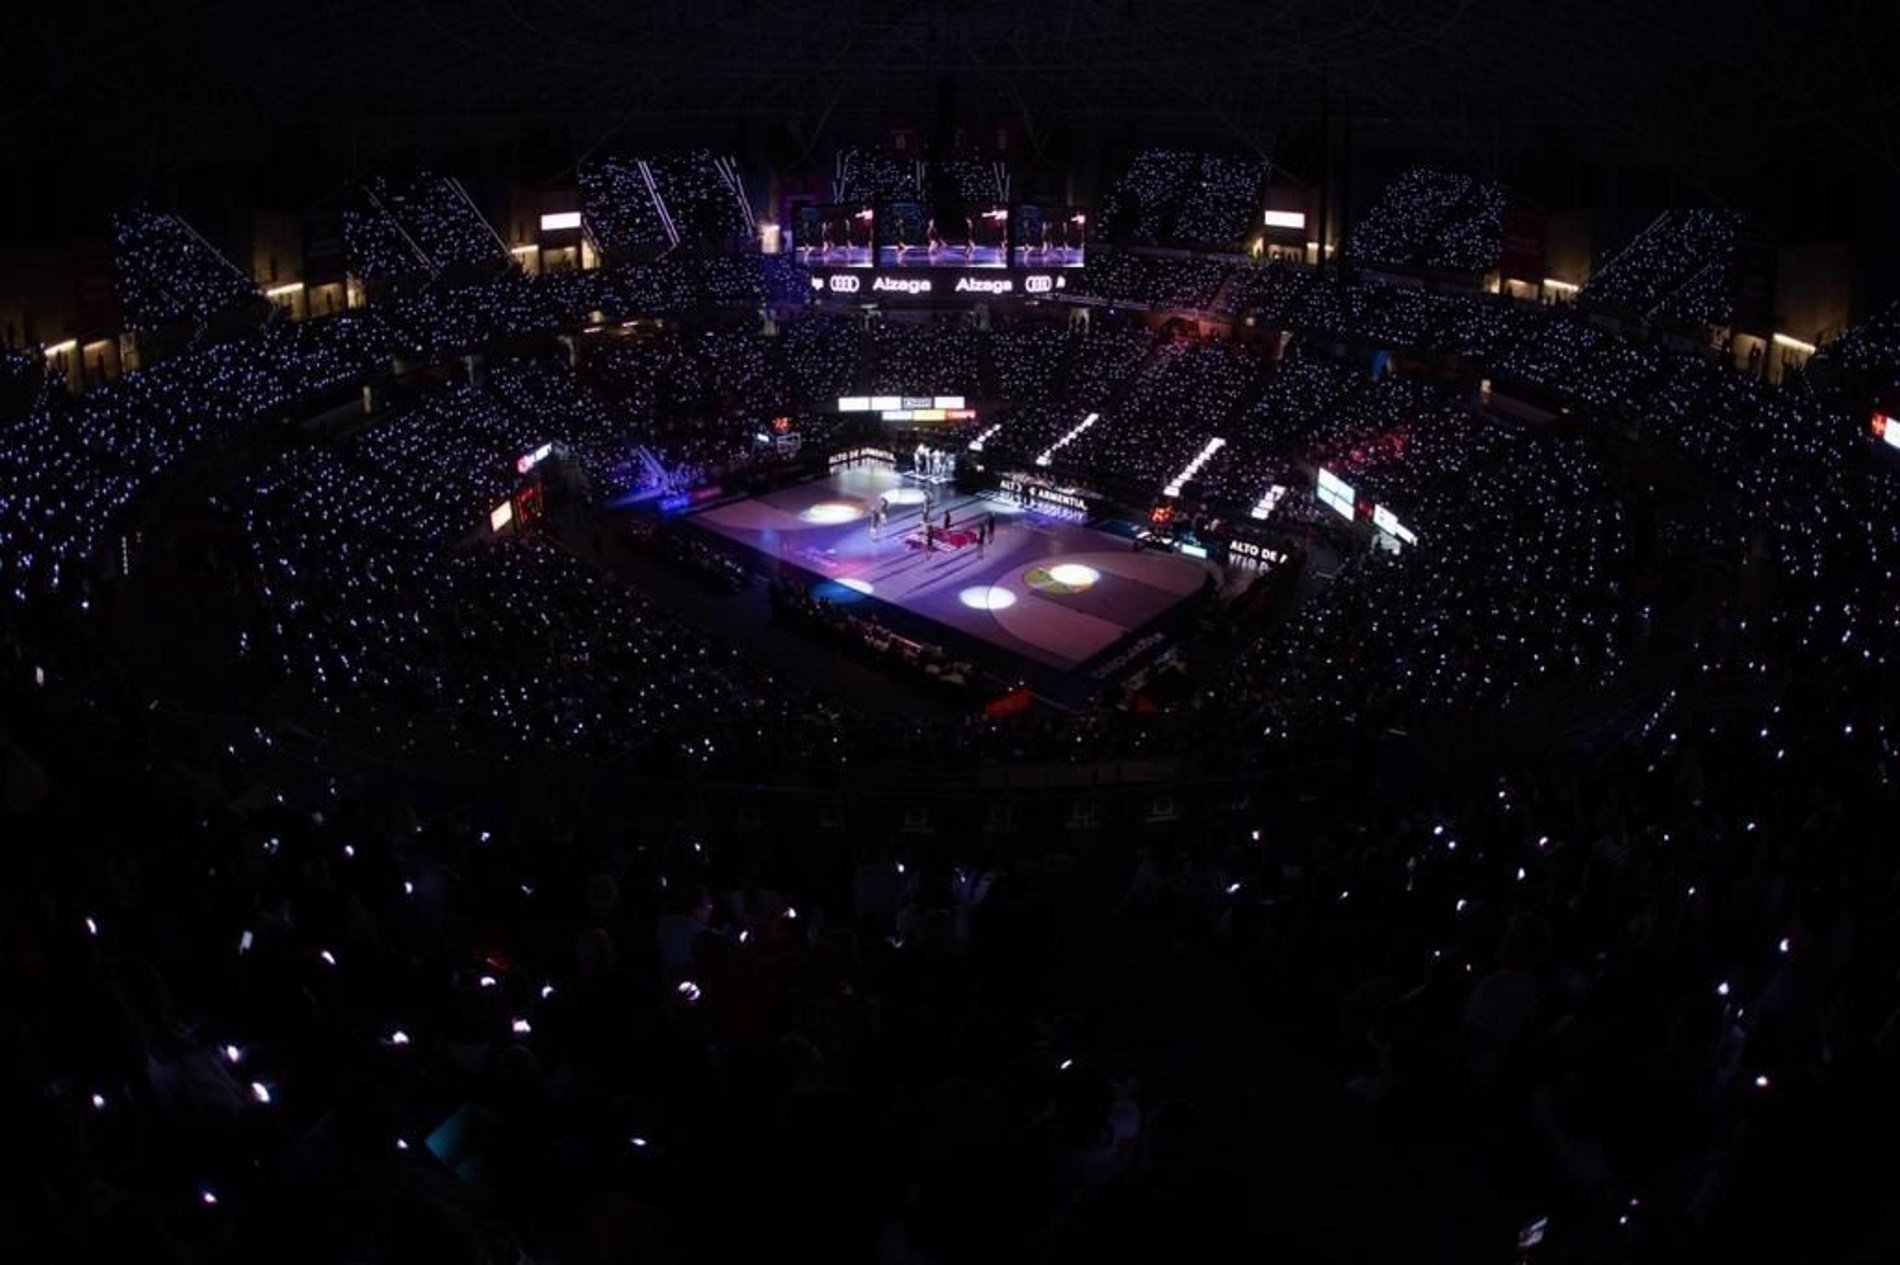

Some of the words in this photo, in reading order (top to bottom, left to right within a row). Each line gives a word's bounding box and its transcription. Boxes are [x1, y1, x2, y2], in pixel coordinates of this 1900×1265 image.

[873, 277, 931, 294] Alzaga
[956, 277, 1013, 294] Alzaga
[1230, 540, 1259, 556] ALTO
[1261, 548, 1278, 562] DE
